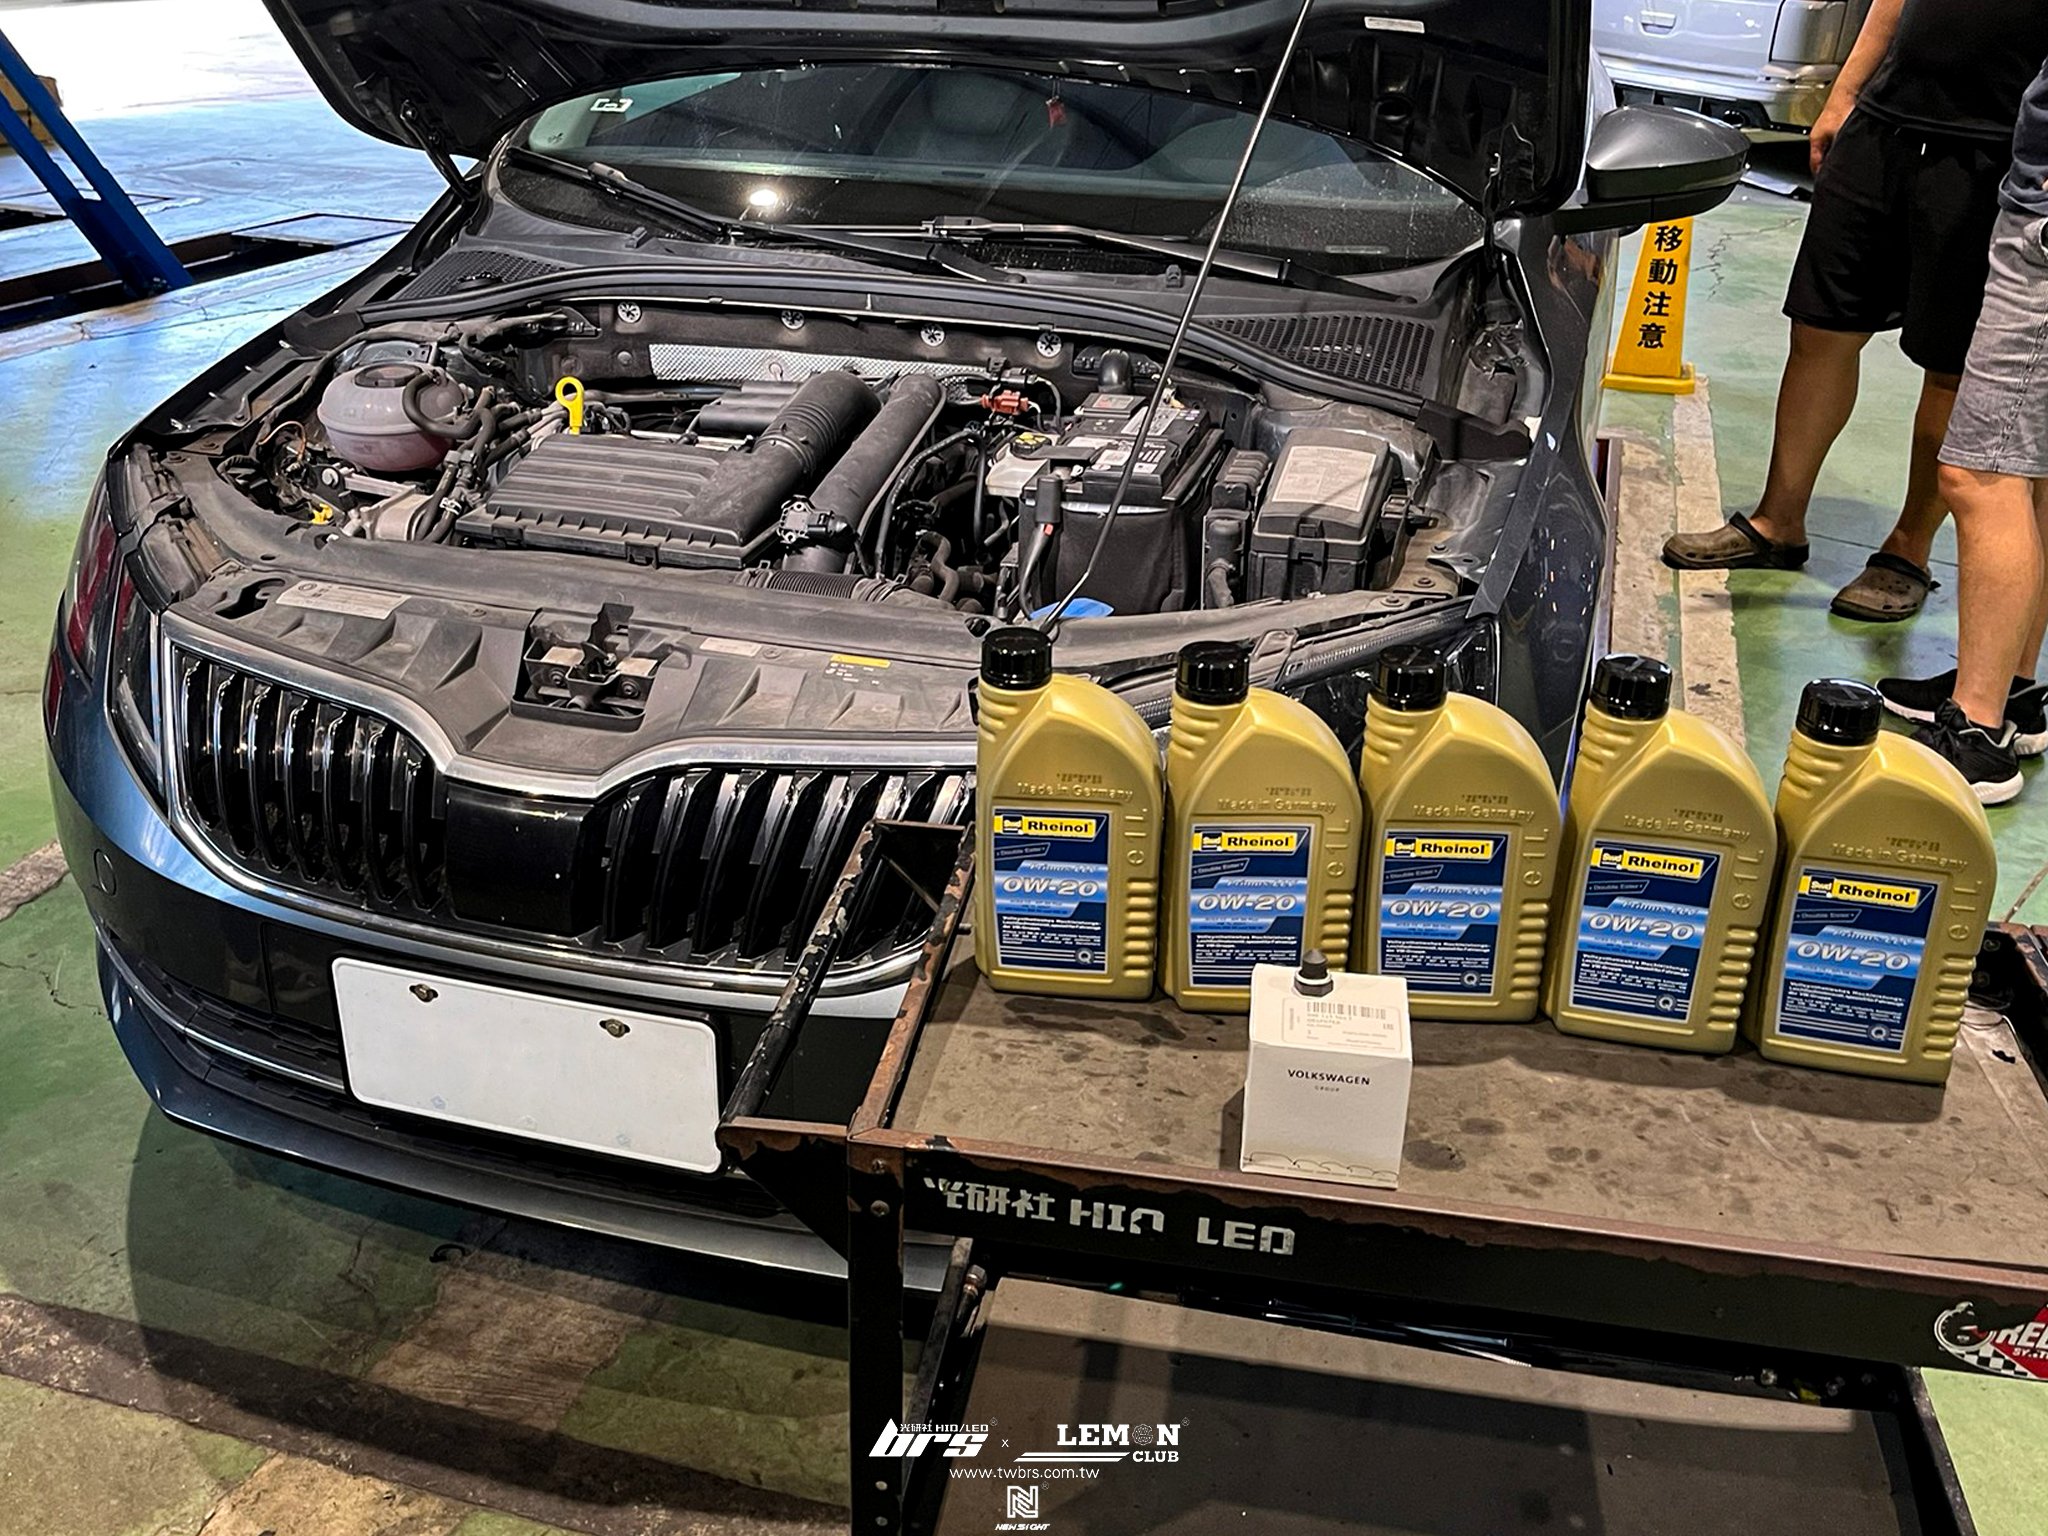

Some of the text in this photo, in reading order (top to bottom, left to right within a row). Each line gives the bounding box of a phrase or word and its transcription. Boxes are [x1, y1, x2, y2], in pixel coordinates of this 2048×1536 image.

[1637, 225, 1684, 349] 移動注意
[1074, 785, 1134, 801] Germany
[1274, 798, 1337, 814] Germany
[1471, 805, 1535, 822] Germany
[1028, 820, 1089, 833] Rheinol
[1684, 819, 1751, 841] Germany
[1227, 836, 1289, 847] Rheinol
[1421, 843, 1485, 854] Rheinol
[1628, 855, 1695, 873] Rheinol
[1896, 849, 1969, 872] Germany
[1003, 876, 1099, 897] 0W-20
[1838, 884, 1911, 903] Rheinol
[1199, 894, 1297, 911] 0W-20
[1389, 900, 1492, 919] 0W-20
[1588, 912, 1695, 941] 0W-20
[1796, 940, 1911, 971] 0W-20
[1288, 1068, 1371, 1086] VOLKSWAGEN
